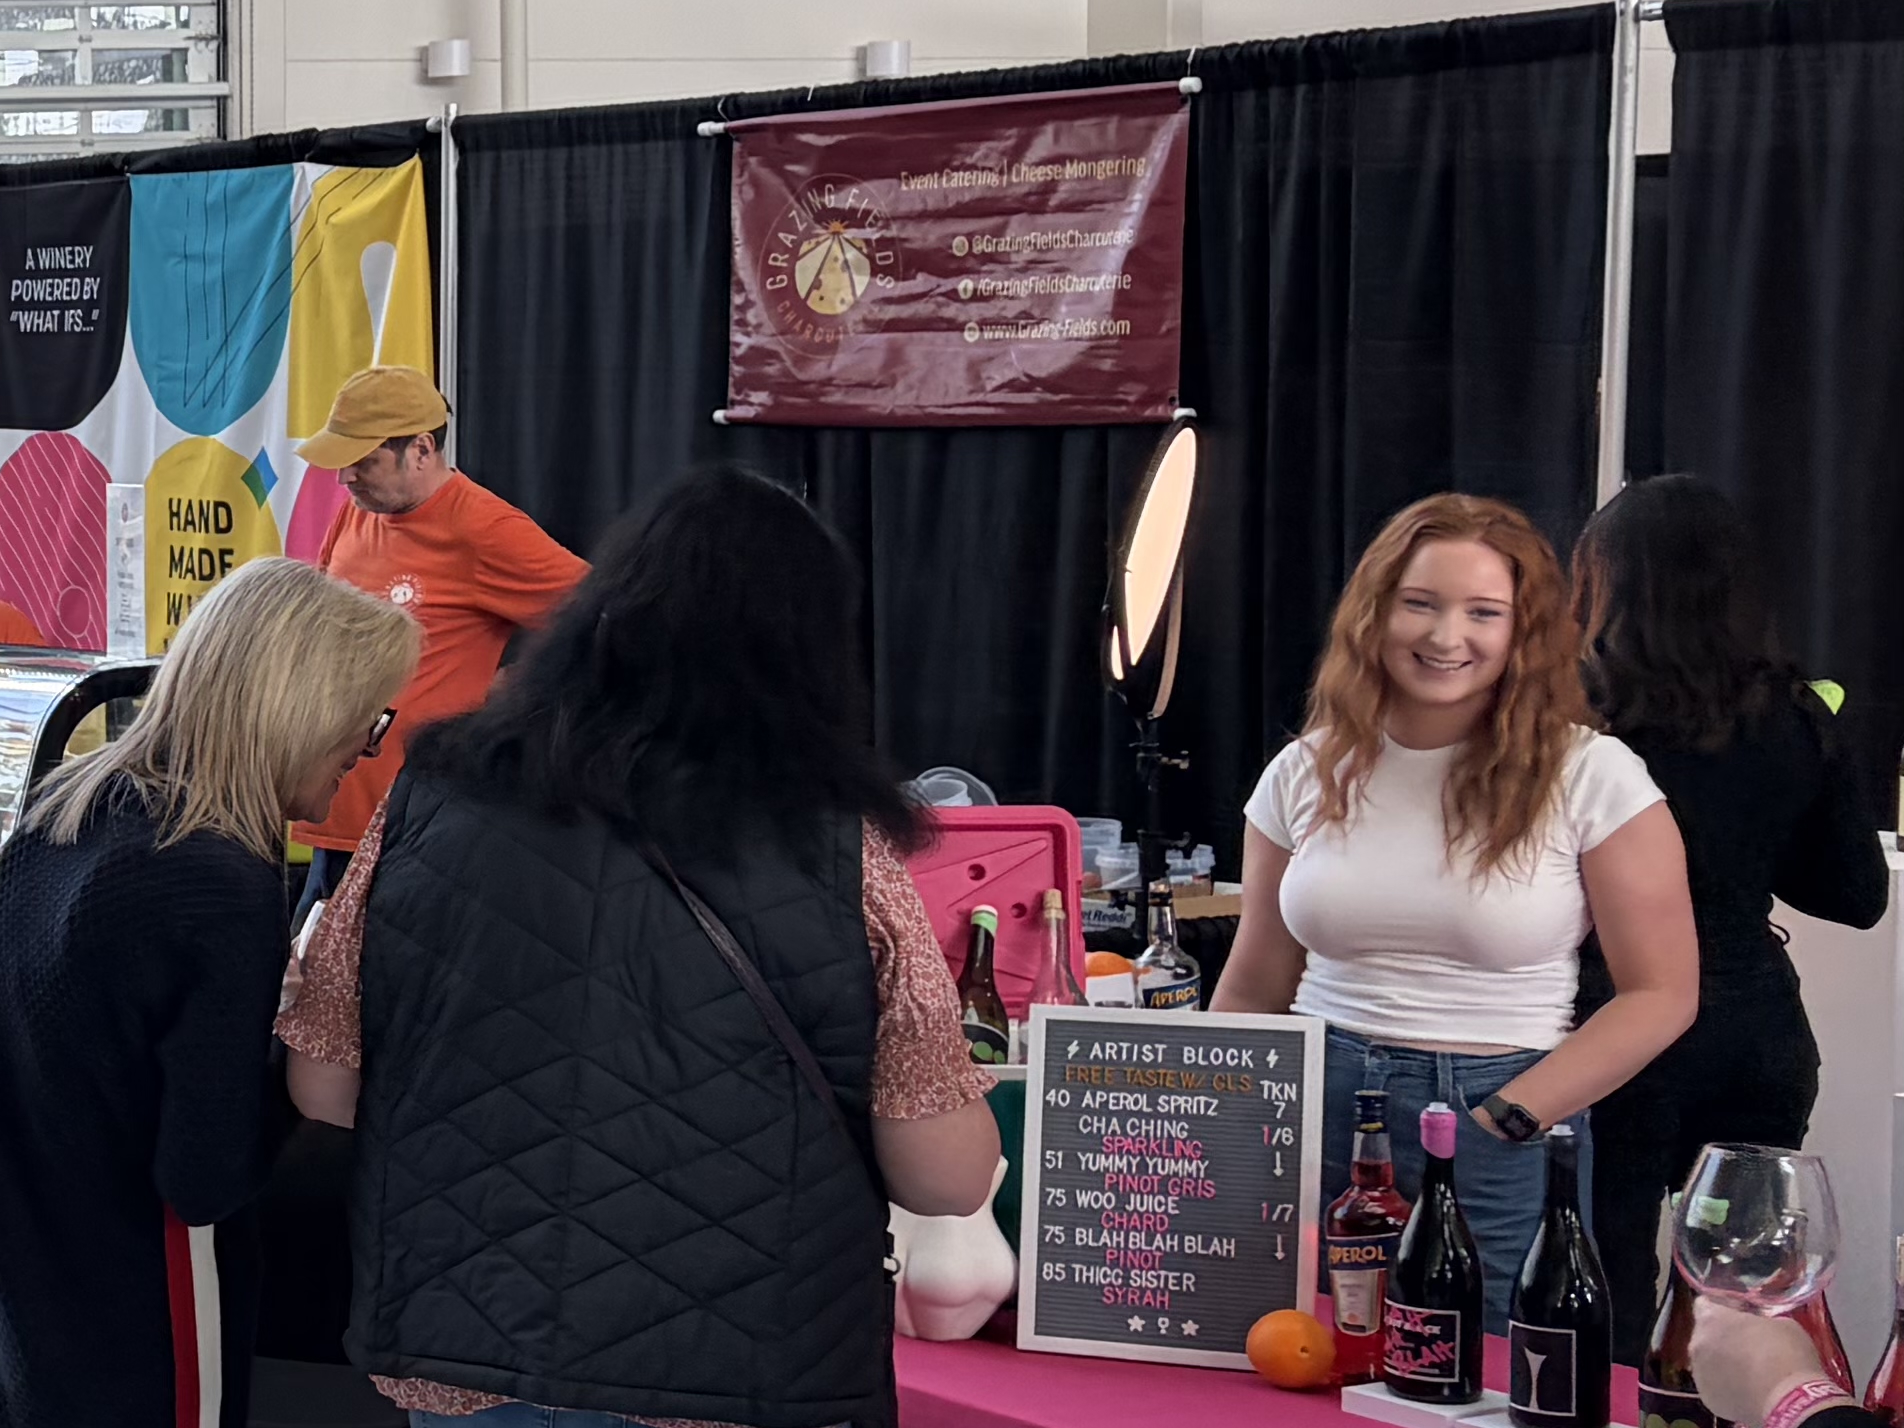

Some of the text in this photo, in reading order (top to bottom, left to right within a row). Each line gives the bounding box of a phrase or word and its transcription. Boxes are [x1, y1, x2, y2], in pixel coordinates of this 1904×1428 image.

[900, 171, 938, 190] Event
[942, 168, 1000, 189] Catering
[1012, 160, 1062, 183] Cheese
[1065, 156, 1146, 180] Mongering
[765, 183, 835, 290] GRAZING
[25, 245, 93, 270] A WINERY
[11, 276, 100, 302] POWERED BY
[168, 497, 233, 535] HAND
[168, 544, 234, 582] MADE
[1090, 1042, 1254, 1069] ARTIST BLOCK
[1065, 1065, 1115, 1084] FREE
[1126, 1067, 1177, 1089] TASTE
[1213, 1074, 1253, 1092] GLS
[1260, 1079, 1297, 1102] TKN
[1045, 1088, 1286, 1119] 40 APEROL SPRITZ 7
[1079, 1114, 1121, 1135] CHA
[1126, 1117, 1190, 1139] CHING
[1102, 1136, 1202, 1158] SPARKLING
[1045, 1150, 1209, 1178] 51 YUMMY YUMMY
[1104, 1173, 1216, 1198] PINOT GRIS
[1045, 1188, 1067, 1207] 75
[1075, 1189, 1116, 1210] WOO
[1125, 1193, 1181, 1215] JUICE
[1100, 1211, 1170, 1232] CHARD
[1043, 1225, 1236, 1258] 75 BLAH BLAH BLAH
[1105, 1249, 1164, 1270] PINOT
[1042, 1262, 1067, 1282] 85
[1128, 1270, 1197, 1293] SISTER
[1102, 1286, 1171, 1310] SYRAH
